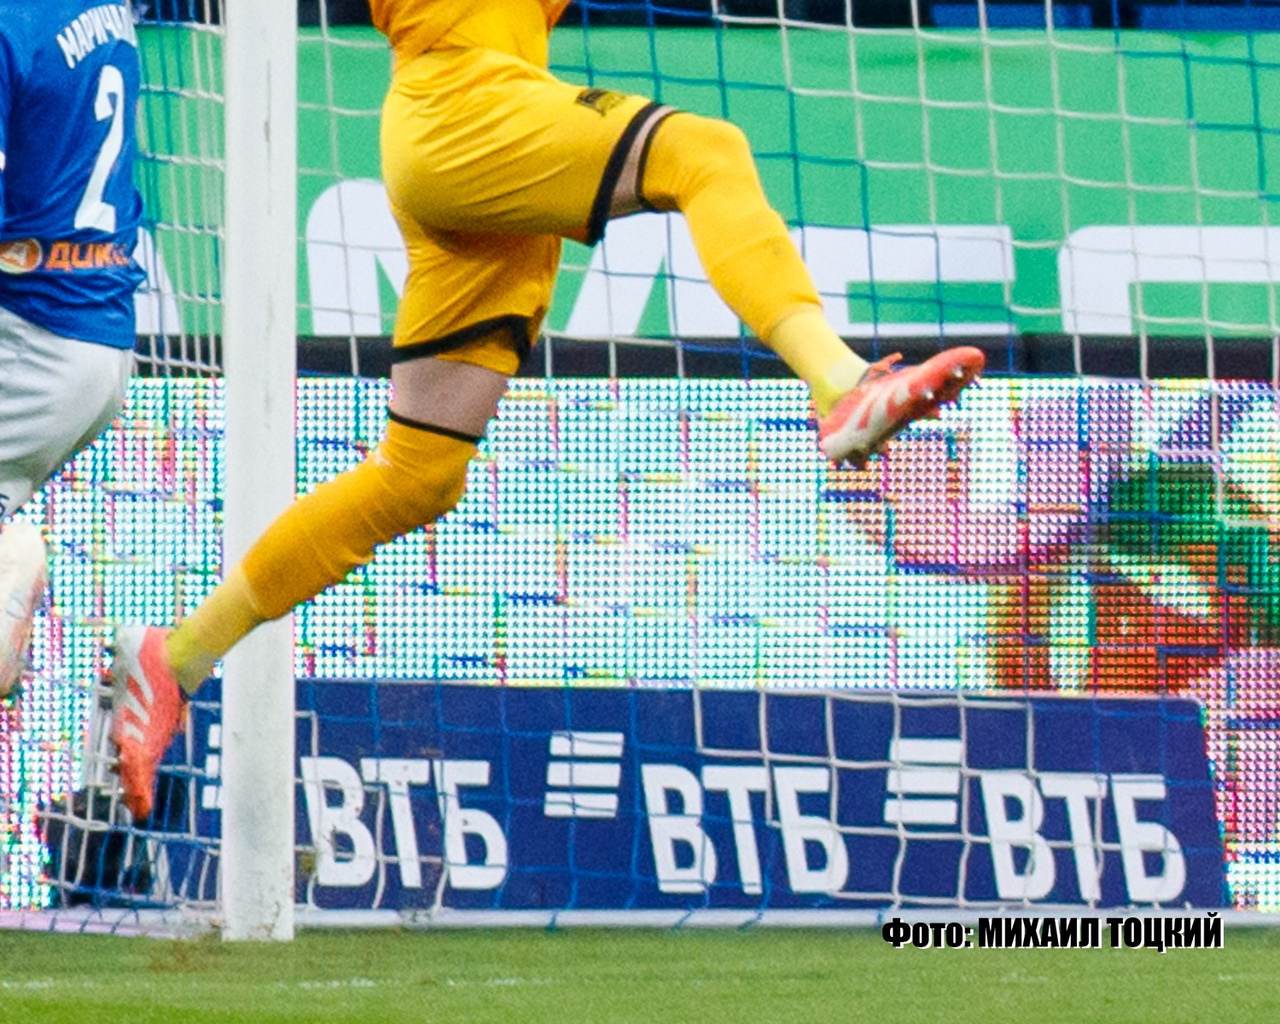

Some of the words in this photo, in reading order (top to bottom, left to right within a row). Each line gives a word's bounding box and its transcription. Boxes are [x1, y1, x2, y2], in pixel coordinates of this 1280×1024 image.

[74, 65, 123, 233] 2
[300, 756, 508, 890] ВТБ
[641, 764, 849, 895] ВТБ
[980, 774, 1187, 903] ВТБ
